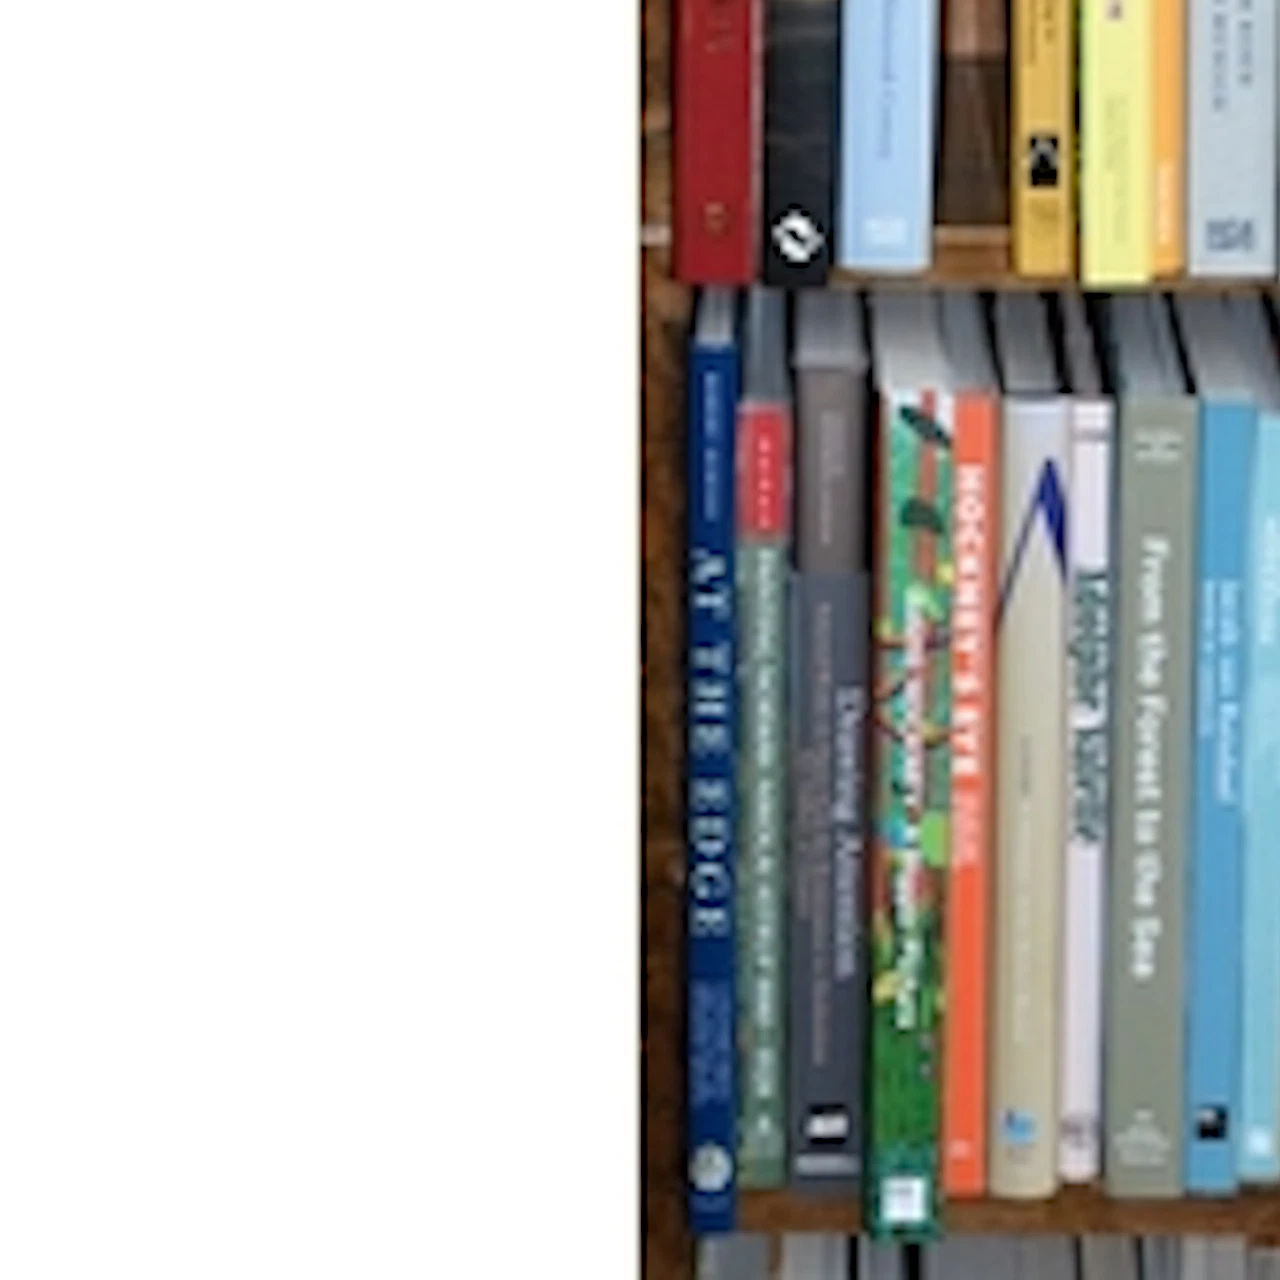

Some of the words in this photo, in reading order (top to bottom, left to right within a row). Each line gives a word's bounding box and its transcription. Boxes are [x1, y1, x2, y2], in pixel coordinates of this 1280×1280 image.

[693, 548, 732, 622] AT
[956, 462, 986, 702] HOCKNEY'S
[1140, 534, 1172, 625] From
[693, 640, 732, 757] THE
[1138, 633, 1170, 689] the
[832, 685, 864, 822] Drawing
[953, 704, 983, 778] EYE
[1136, 694, 1169, 805] Forest
[691, 778, 733, 939] EDGE
[1135, 809, 1165, 843] to
[833, 832, 864, 980] Attention
[1134, 850, 1164, 909] the
[1132, 915, 1161, 980] Sea
